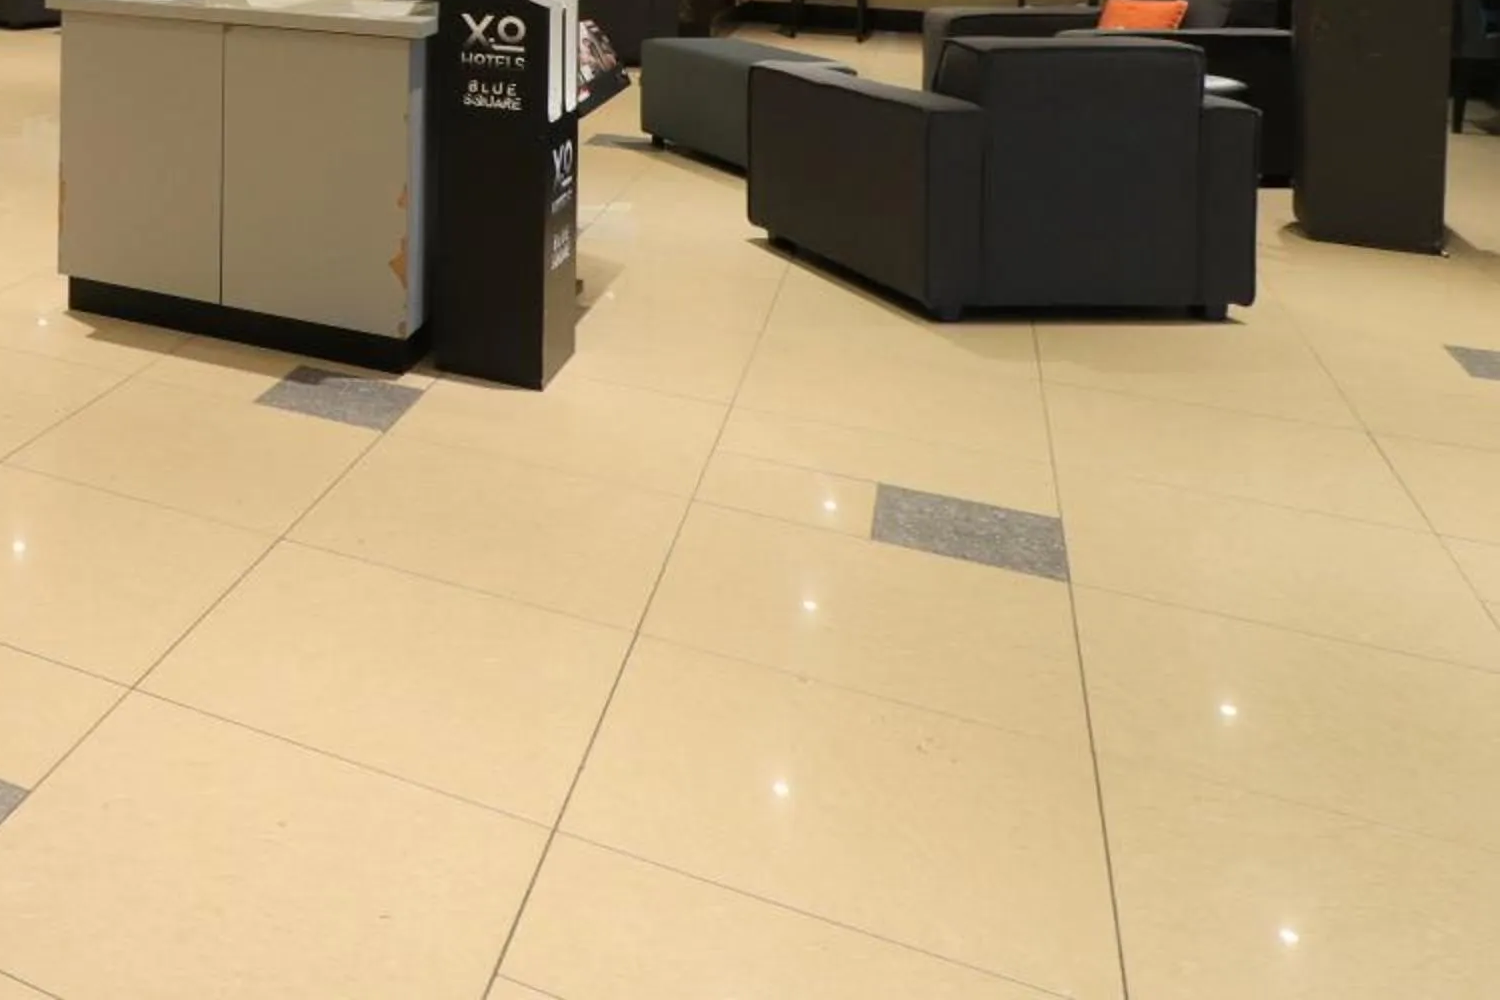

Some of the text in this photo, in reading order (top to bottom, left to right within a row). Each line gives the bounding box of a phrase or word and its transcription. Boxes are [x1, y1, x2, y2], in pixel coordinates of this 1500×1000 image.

[461, 51, 526, 70] HOTELS
[467, 79, 518, 97] BLUE
[462, 93, 523, 112] SQUARE
